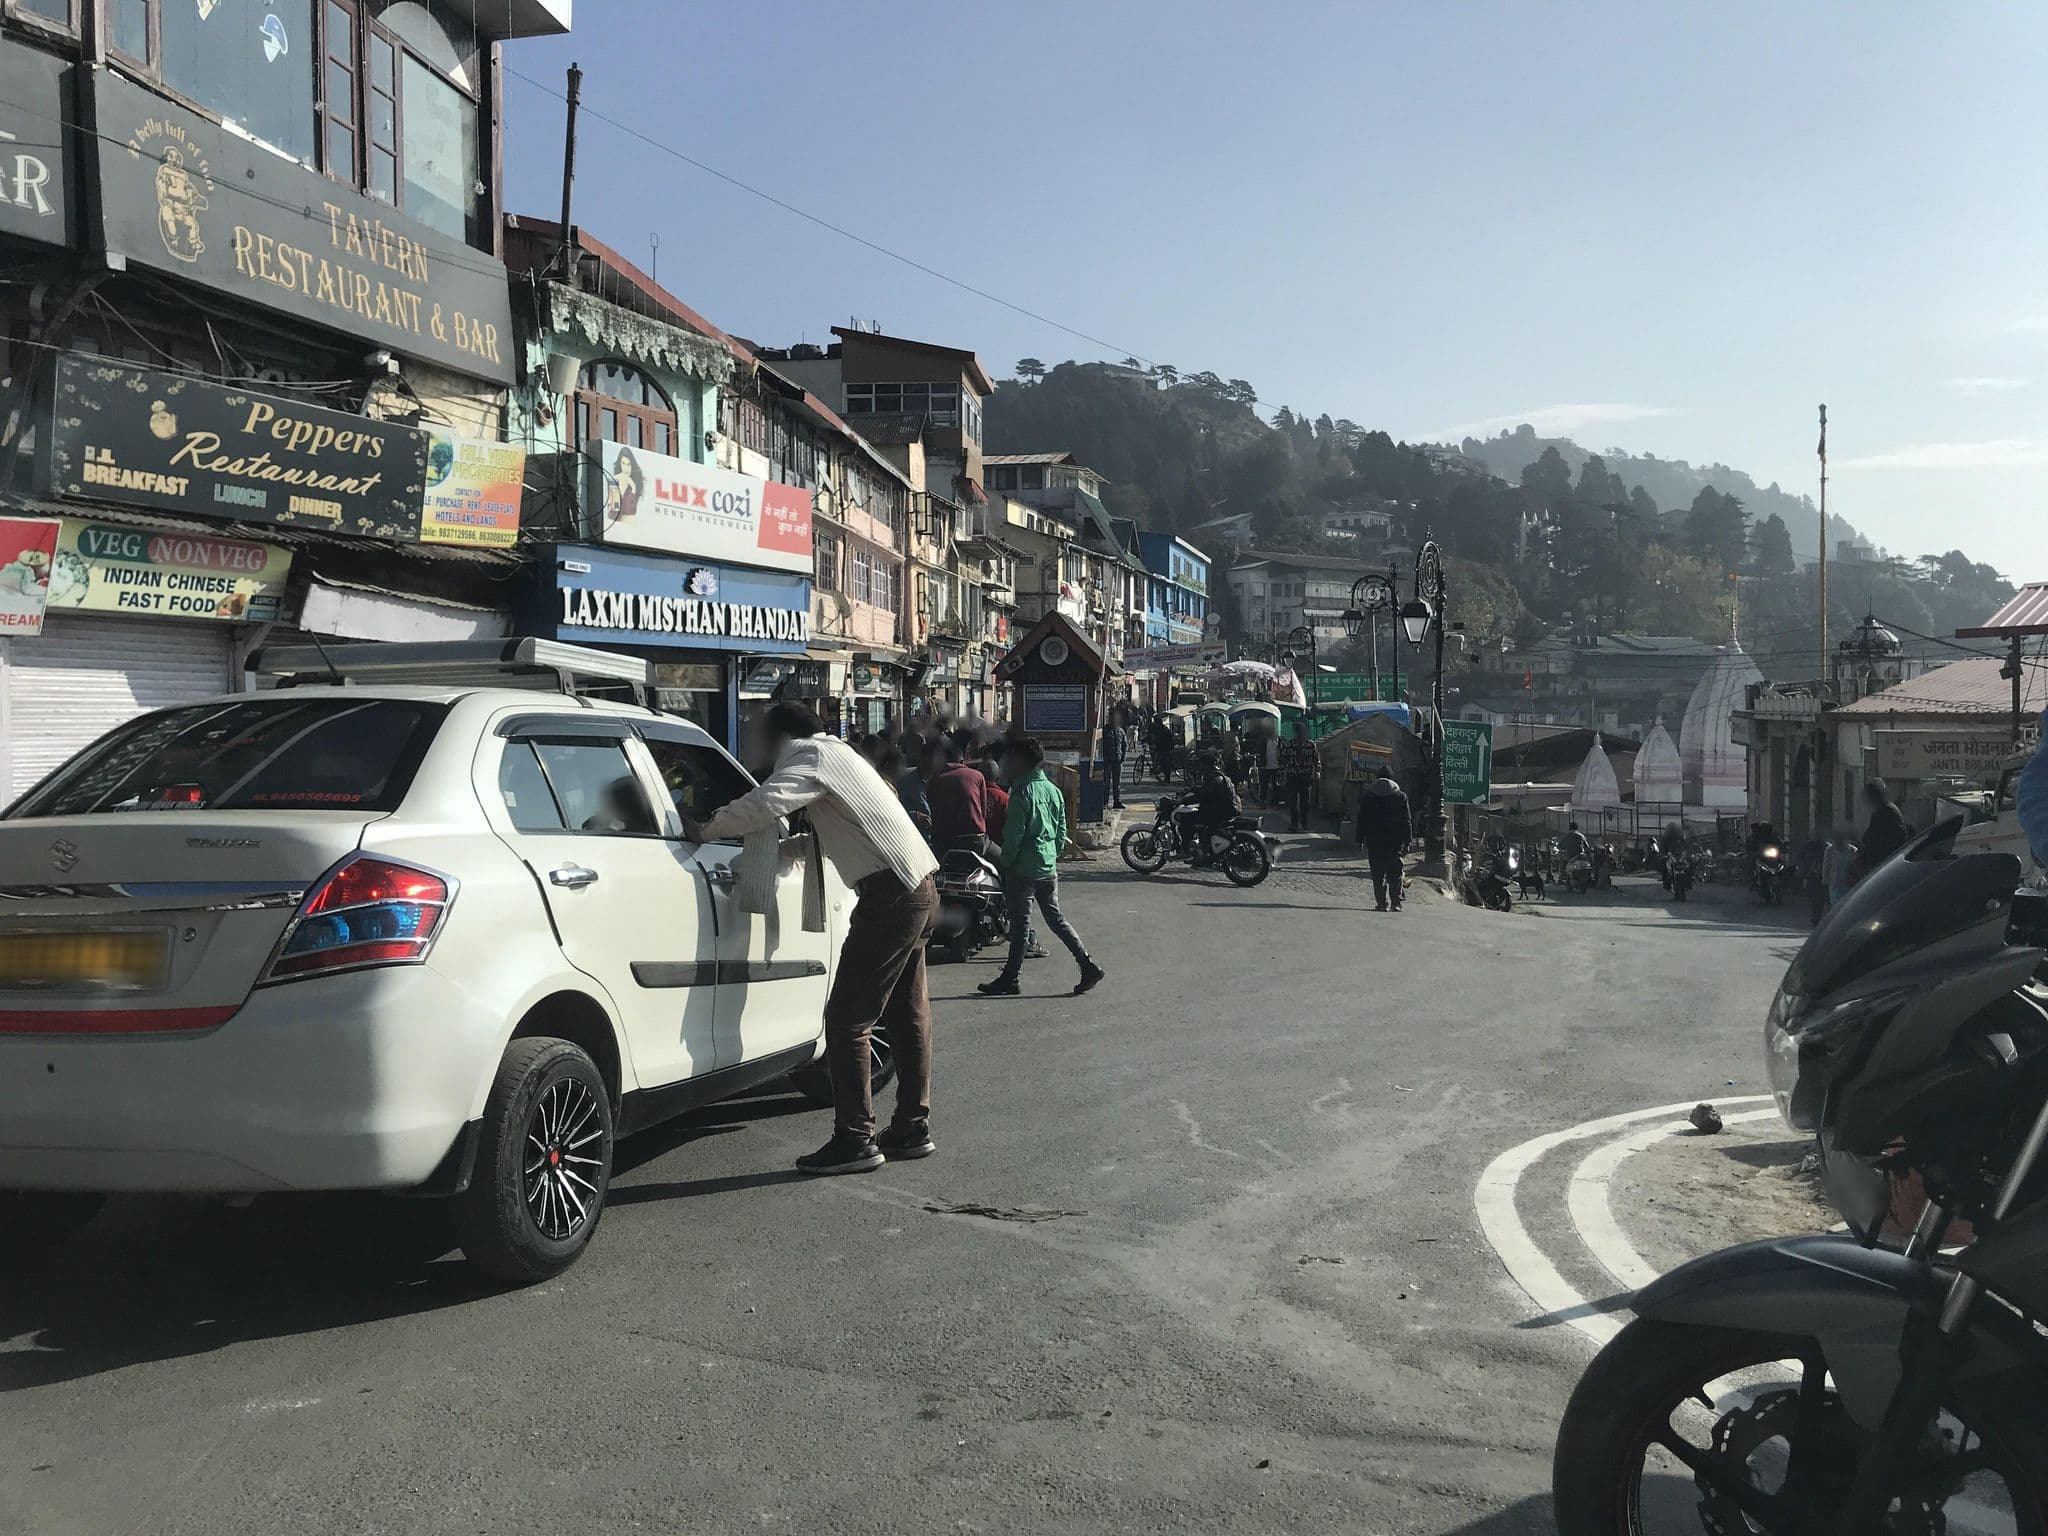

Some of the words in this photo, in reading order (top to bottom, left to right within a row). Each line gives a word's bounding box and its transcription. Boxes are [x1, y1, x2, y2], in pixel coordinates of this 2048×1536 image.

[165, 119, 186, 142] full
[322, 200, 429, 284] TAVERN
[232, 225, 423, 333] RESTAURANT
[430, 303, 448, 343] &
[454, 311, 501, 365] BAR
[241, 401, 386, 459] Peppers
[170, 431, 382, 497] Restaurant
[83, 462, 190, 497] BREAKFAST
[213, 483, 267, 508] LUNCH
[289, 494, 343, 520] DINNER
[712, 487, 753, 518] cozi
[86, 529, 142, 558] VEG
[154, 539, 210, 567] NON
[218, 545, 264, 571] VEG
[104, 567, 162, 588] INDIAN
[167, 573, 236, 594] CHINESE
[118, 591, 164, 610] FAST
[169, 596, 216, 613] FOOD
[562, 586, 635, 630] LAXMI
[639, 594, 727, 636] MISTHAN
[729, 603, 811, 642] BHANDAR
[1446, 725, 1478, 741] देहरादून
[1446, 741, 1472, 754] हरिद्वार
[1922, 740, 1961, 755] जनता
[1445, 755, 1468, 769] दिल्ली
